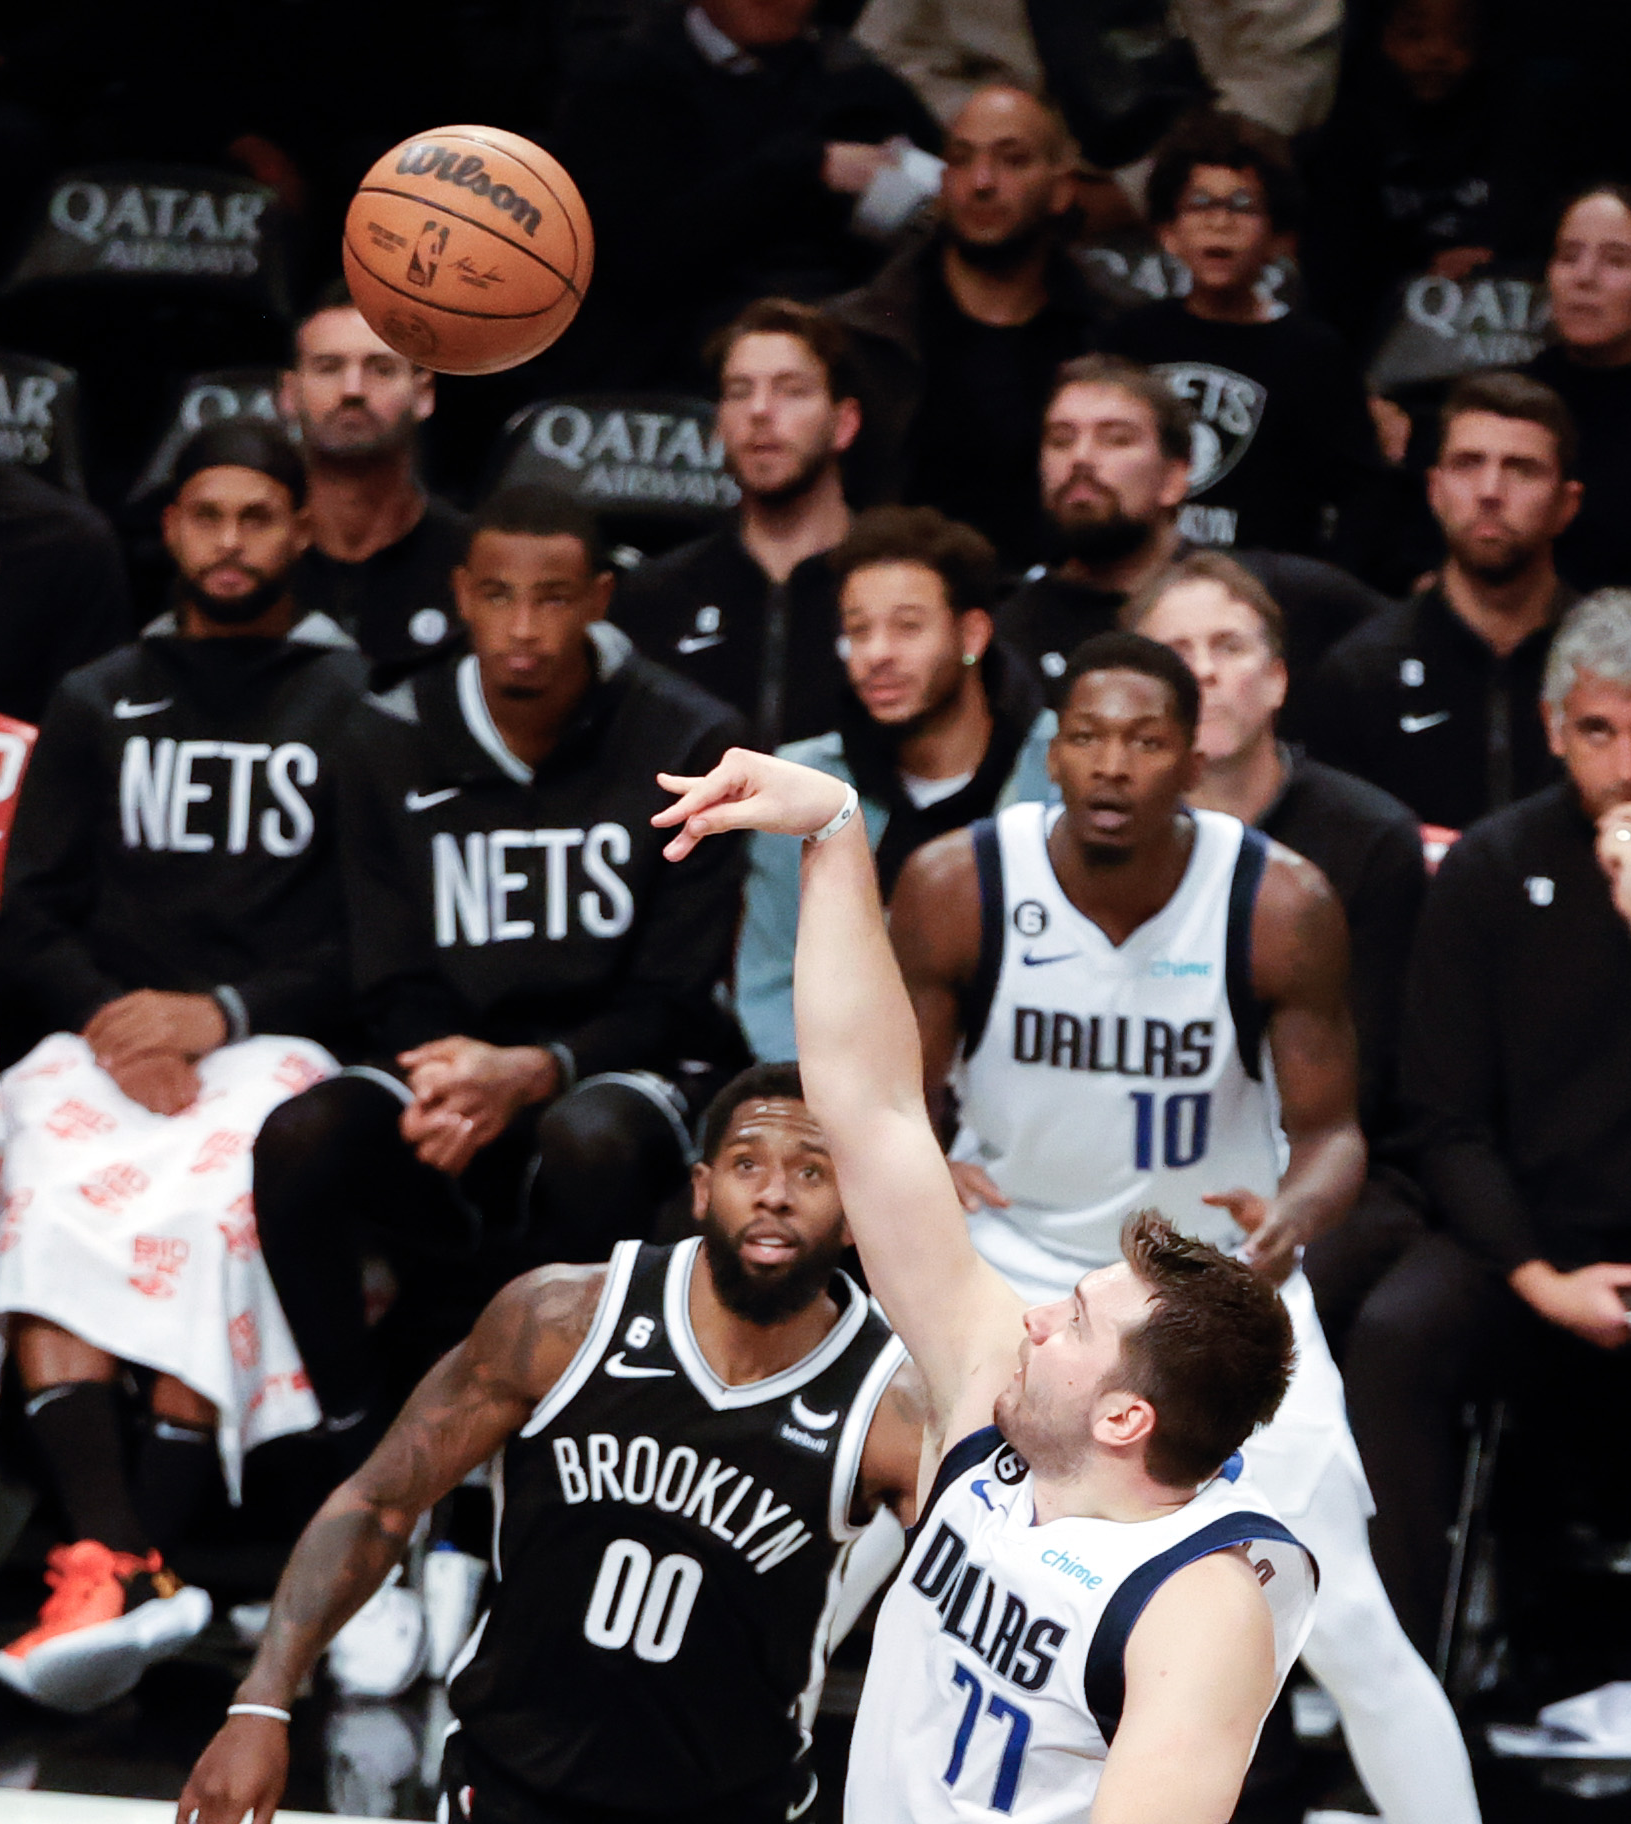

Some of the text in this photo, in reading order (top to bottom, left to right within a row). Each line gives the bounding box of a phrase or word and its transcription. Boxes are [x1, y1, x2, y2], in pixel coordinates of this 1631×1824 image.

[49, 180, 268, 245] QATAR
[396, 143, 543, 238] Wilson
[1404, 275, 1554, 339] QAT
[119, 735, 318, 857] NETS
[431, 821, 635, 948] NETS
[1013, 1008, 1215, 1079] DALLAS
[1128, 1091, 1212, 1171] 10
[625, 1315, 656, 1350] 6
[780, 1424, 829, 1454] Webull
[995, 1454, 1026, 1482] 6
[553, 1432, 813, 1575] BROOKLYN
[583, 1537, 704, 1664] 00
[909, 1518, 1071, 1694] DALLAS
[1041, 1547, 1104, 1591] chime
[942, 1661, 1033, 1818] 77
